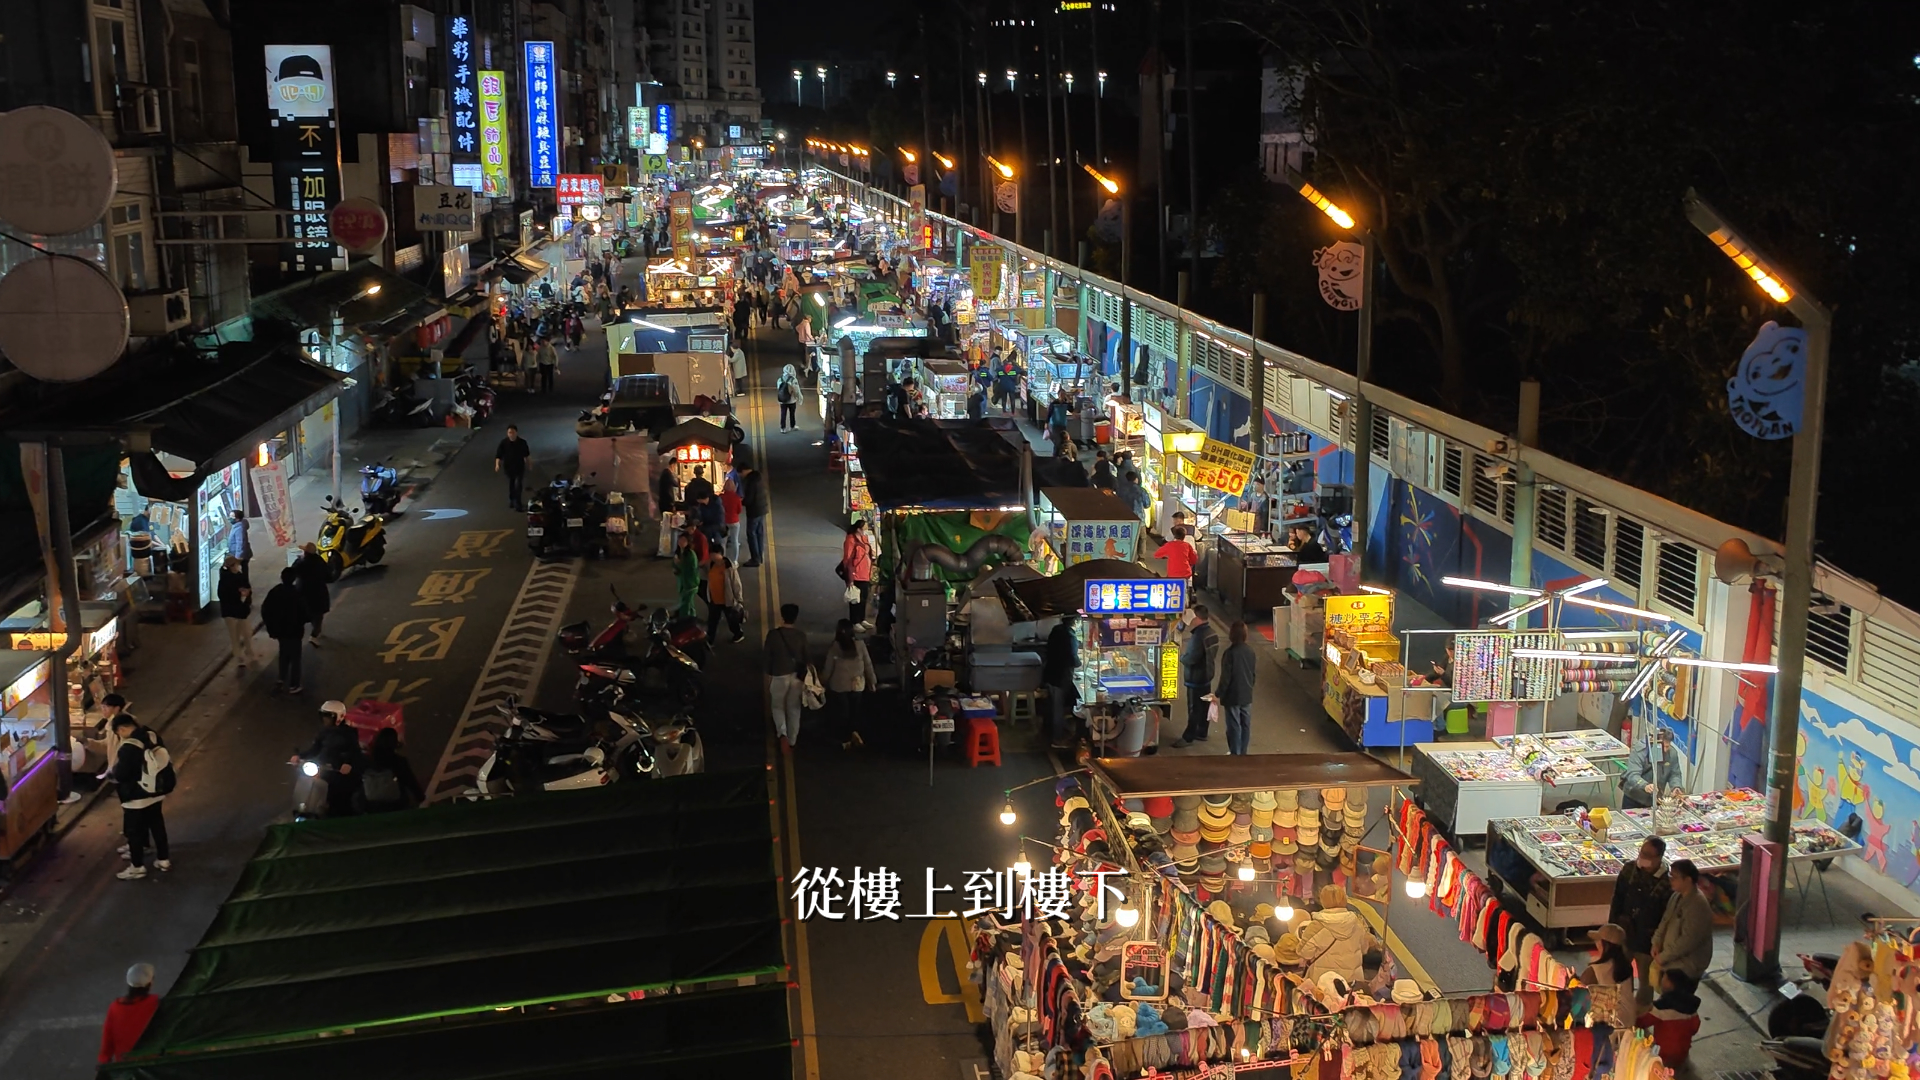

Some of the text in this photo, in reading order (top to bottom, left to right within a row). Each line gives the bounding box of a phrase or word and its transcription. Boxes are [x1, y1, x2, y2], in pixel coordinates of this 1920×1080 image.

[452, 16, 476, 153] 華彩手機配件
[481, 76, 503, 166] 銀匠飾品
[299, 125, 330, 249] 不二加眼鏡
[559, 178, 601, 192] 廣東腸粉
[438, 192, 471, 210] 豆花
[1320, 279, 1359, 309] CHUNGLI
[1730, 394, 1795, 438] TAOYUAN
[1101, 583, 1182, 610] 營養三明治
[1329, 611, 1386, 625] 糖炒栗子
